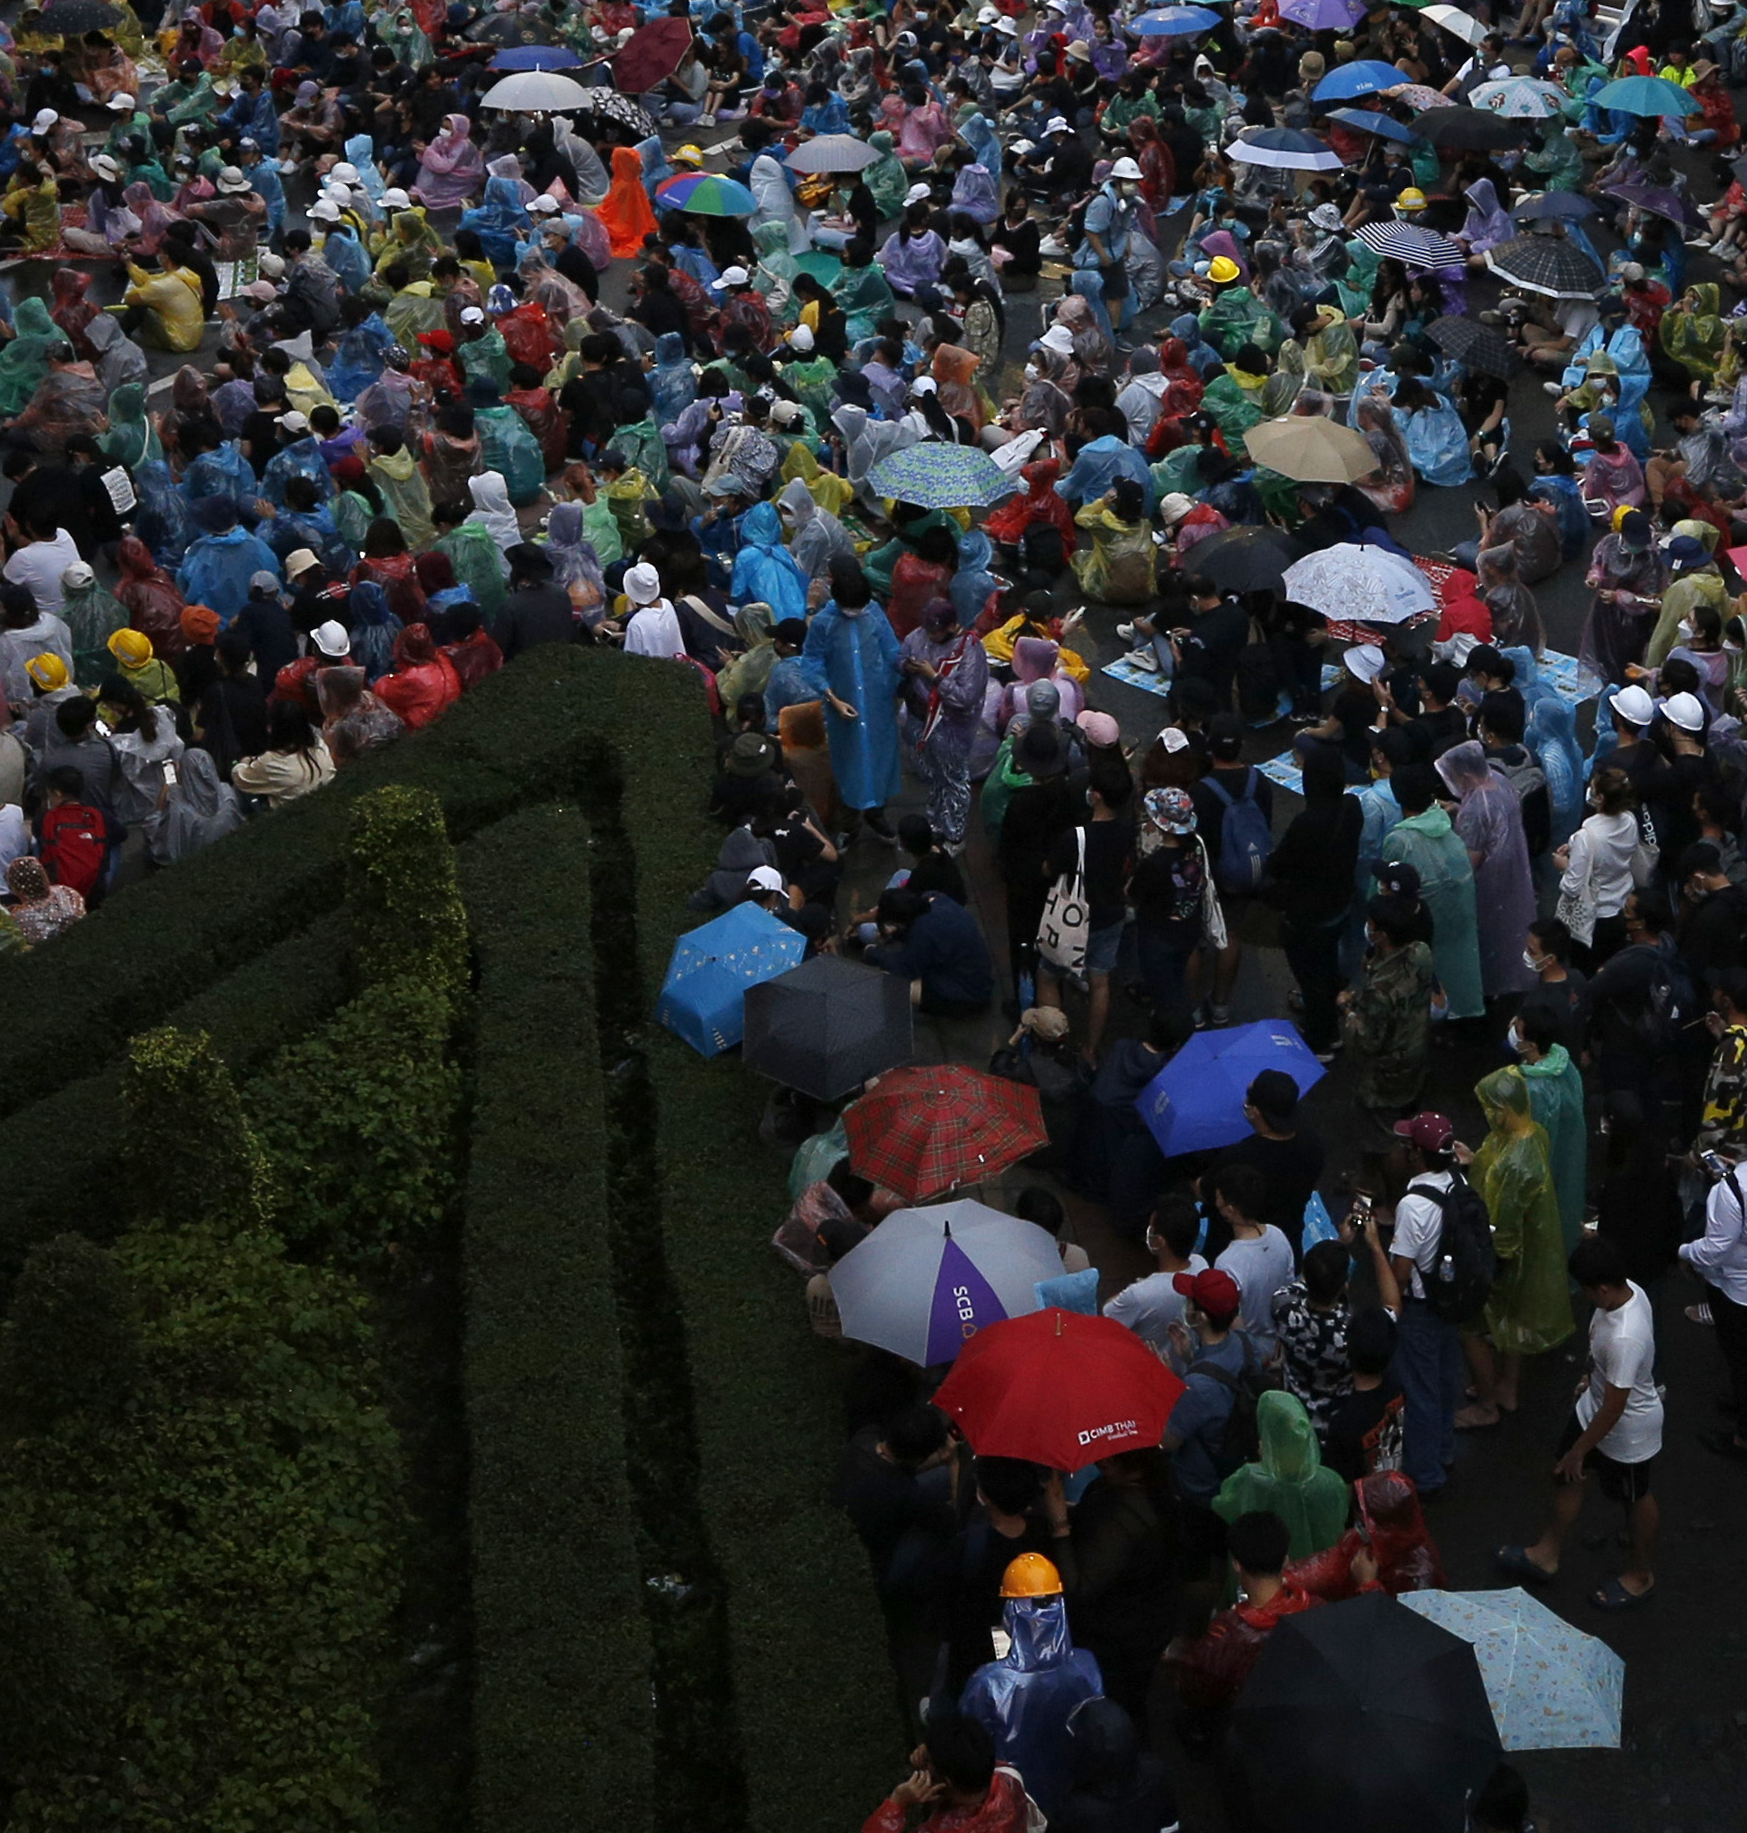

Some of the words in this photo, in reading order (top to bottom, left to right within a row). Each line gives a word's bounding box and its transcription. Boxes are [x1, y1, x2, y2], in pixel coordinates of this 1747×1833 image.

[1642, 802, 1658, 847] didas
[953, 1285, 974, 1321] SCB
[1089, 1423, 1115, 1440] CIMB
[1114, 1419, 1137, 1434] THAI
